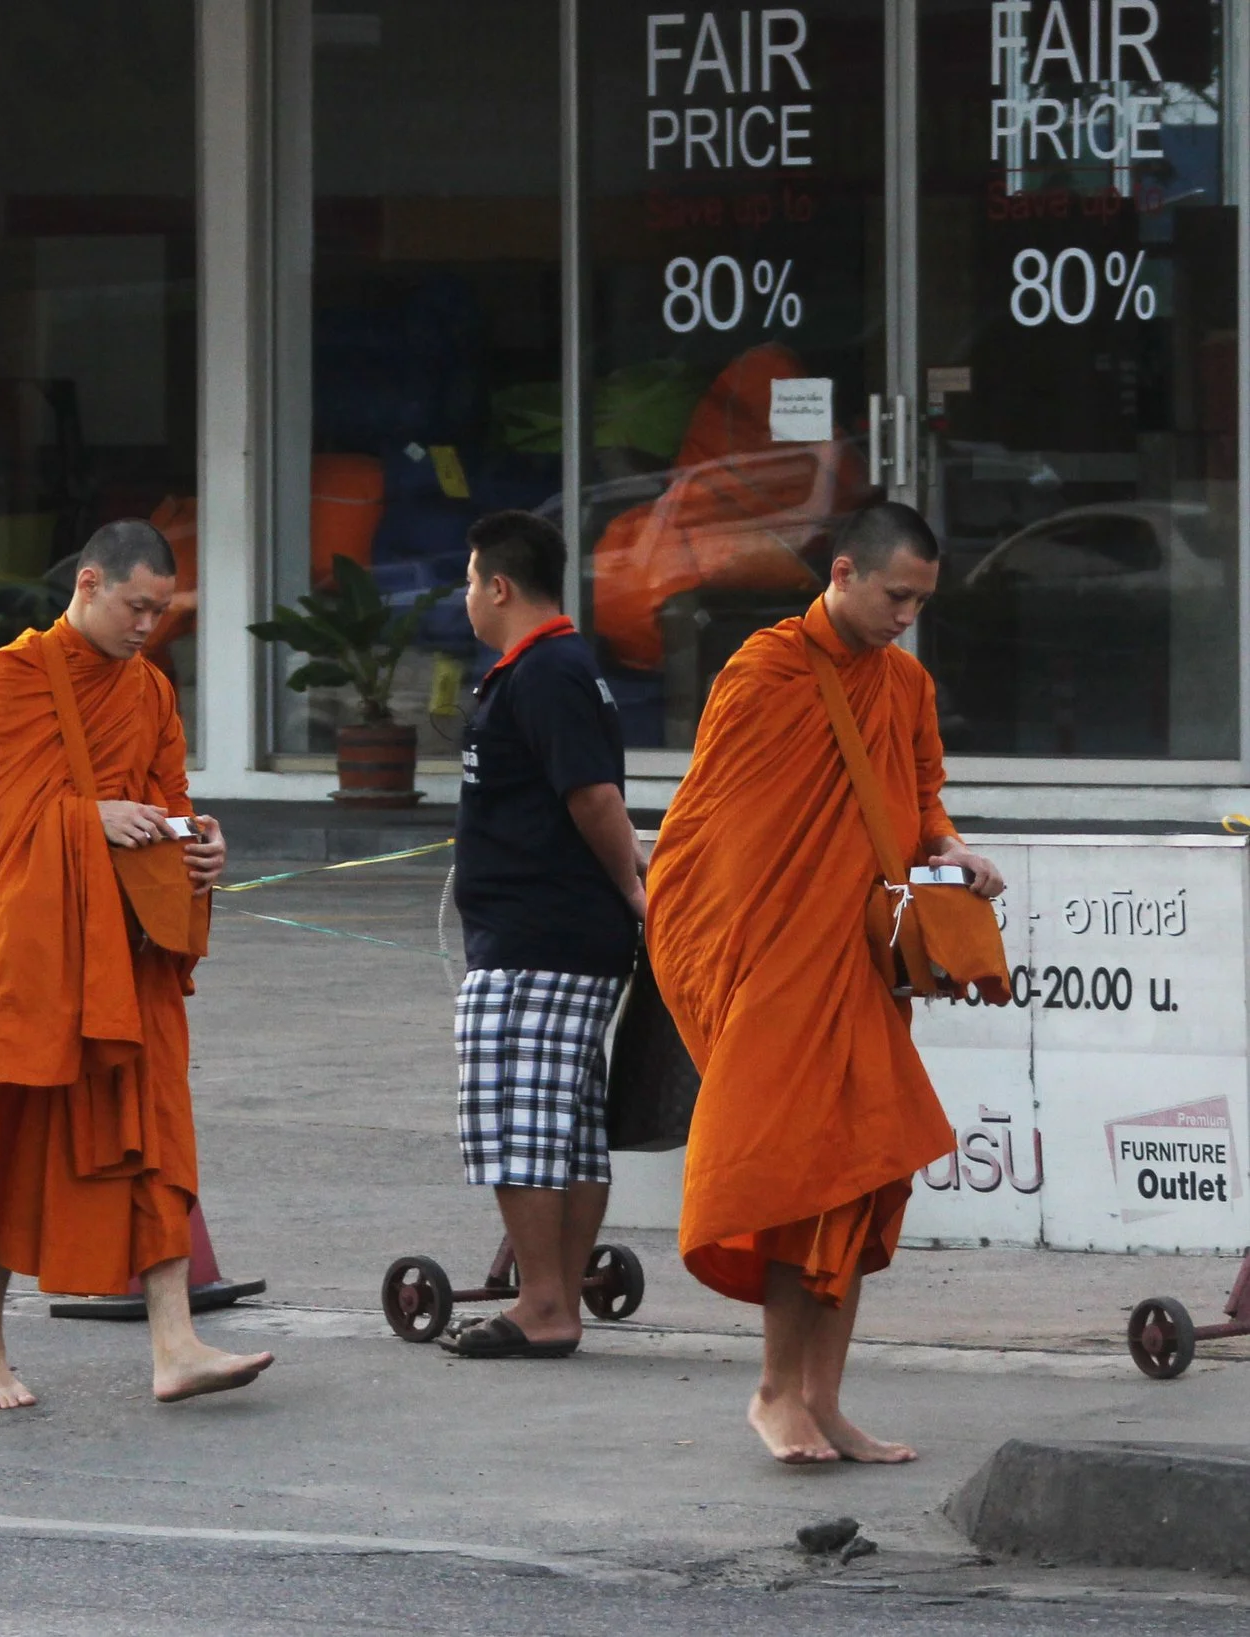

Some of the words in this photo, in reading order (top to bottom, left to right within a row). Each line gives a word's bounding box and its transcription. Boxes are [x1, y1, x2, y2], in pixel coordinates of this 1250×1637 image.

[647, 8, 811, 96] FAIR
[991, 0, 1162, 85] FAIR
[647, 104, 812, 170] PRICE
[991, 96, 1165, 161] PRICE
[662, 254, 802, 333] 80%
[1010, 247, 1156, 326] 80%
[1063, 886, 1187, 937] อาทิตย์
[1149, 977, 1179, 1012] น.
[1120, 1140, 1227, 1164] FURNITURE
[1176, 1112, 1227, 1127] Premium
[1137, 1168, 1228, 1203] Outlet
